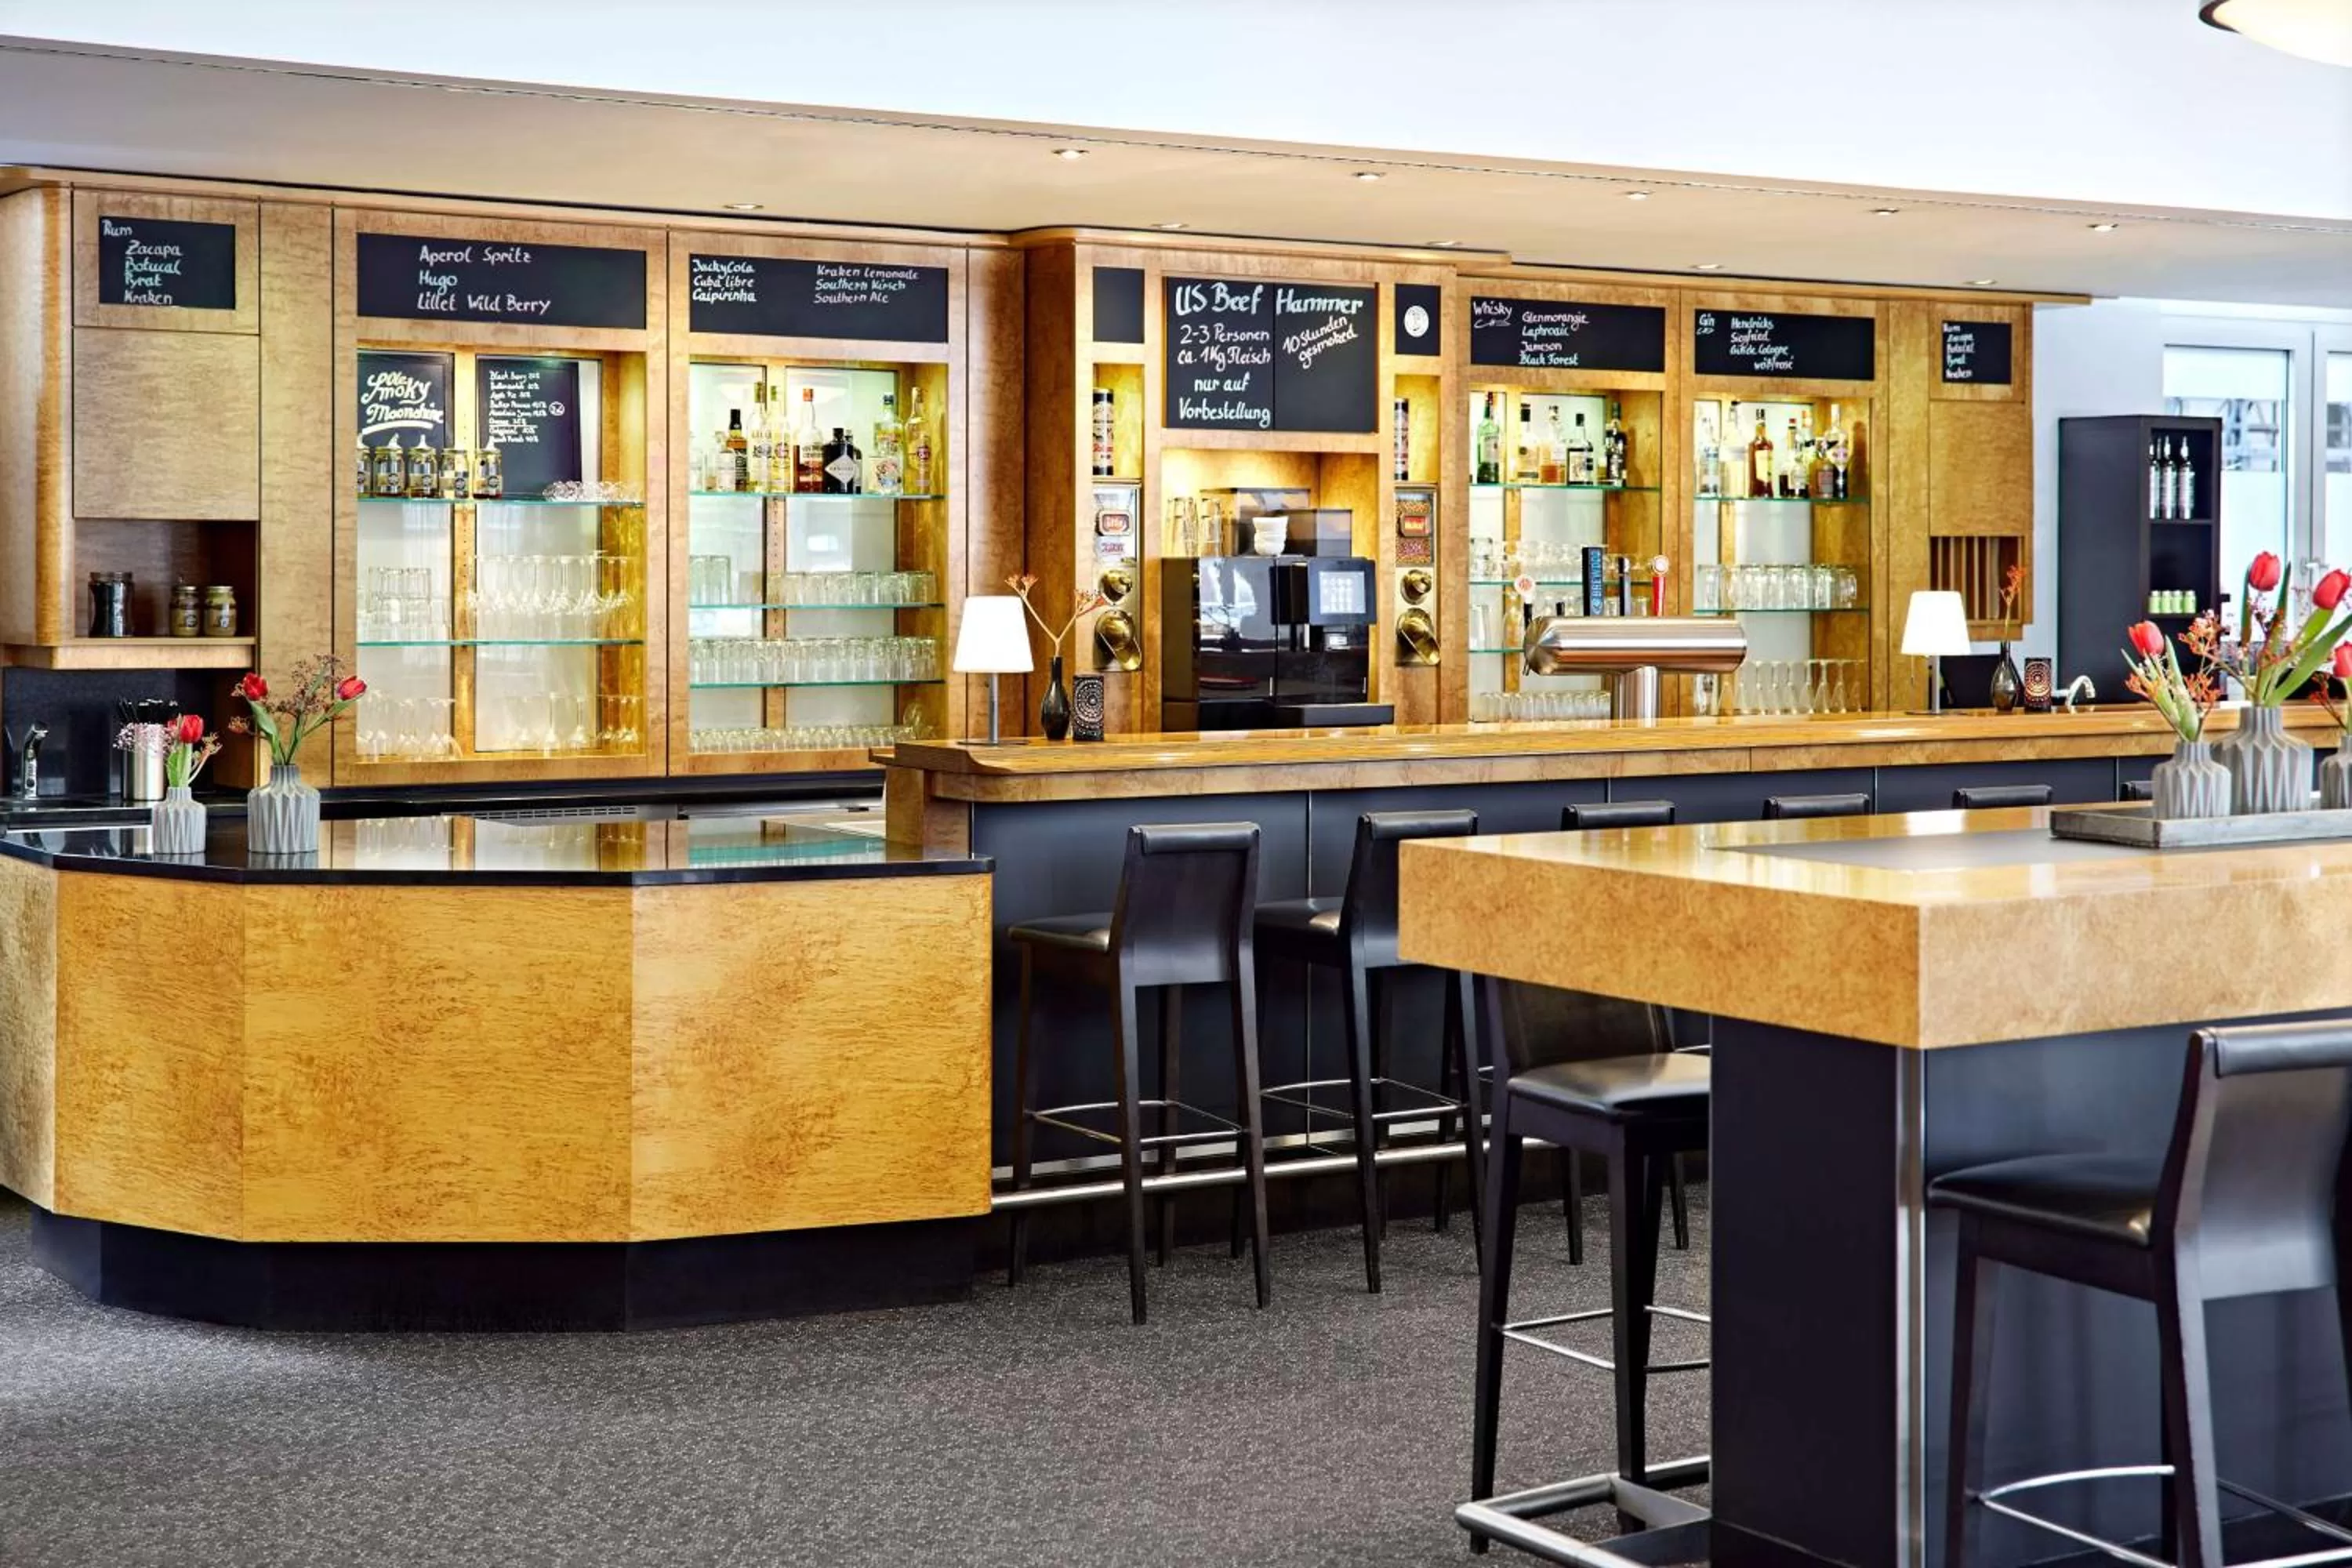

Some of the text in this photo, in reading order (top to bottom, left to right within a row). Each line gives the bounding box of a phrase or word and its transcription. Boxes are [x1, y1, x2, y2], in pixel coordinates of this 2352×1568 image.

[125, 239, 183, 259] Zacapa
[419, 244, 533, 267] Aperol Spritz
[693, 274, 722, 288] Cuba
[816, 264, 861, 278] Kraken
[419, 269, 458, 296] Hugo
[815, 277, 868, 291] Southern
[124, 289, 172, 305] Kraken
[417, 291, 551, 317] Lillet Wild Berry
[692, 286, 757, 305] Caipirinha
[813, 291, 867, 304] Southern
[1175, 282, 1364, 316] US Beef Hammer
[1473, 300, 1512, 321] Whisky
[1699, 313, 1715, 327] Gin
[1180, 322, 1270, 344] 2-3 Personen
[1282, 314, 1348, 354] 10 Stunden
[1177, 349, 1197, 365] ca.
[1227, 346, 1271, 365] Fleisch
[1521, 341, 1563, 352] Jameson
[1194, 371, 1250, 392] nur auf
[1179, 397, 1271, 428] Vorbestellung
